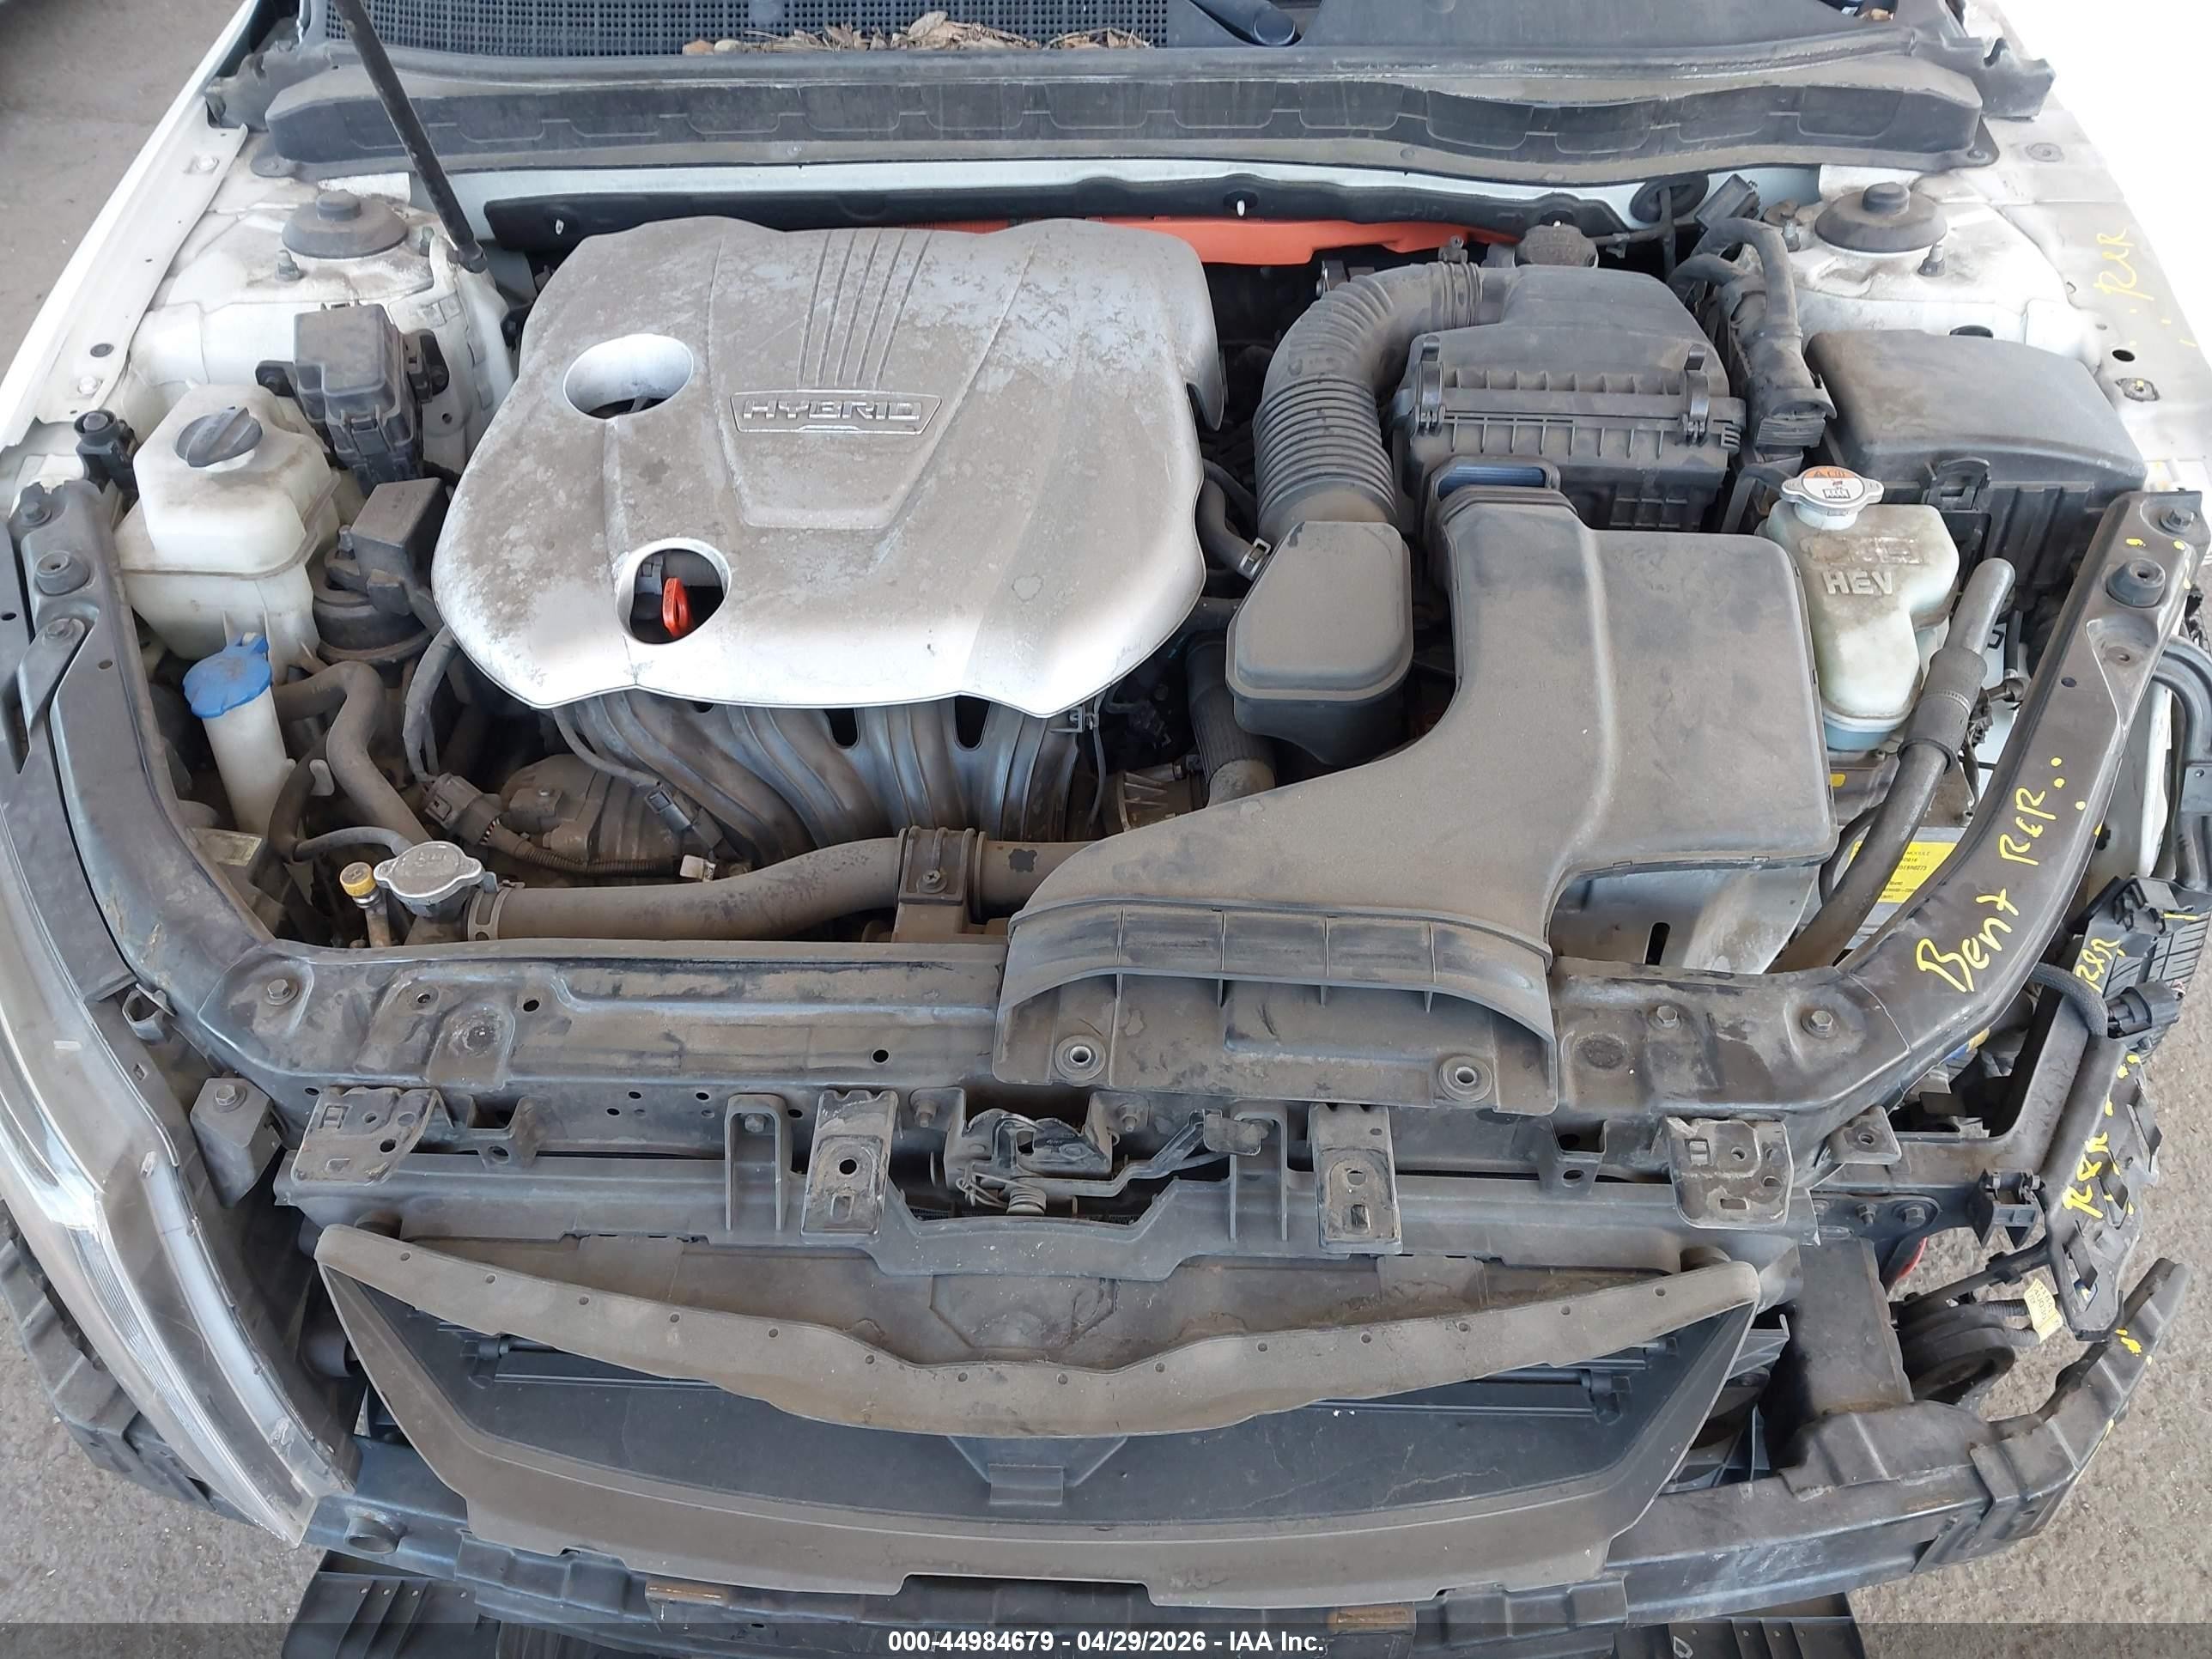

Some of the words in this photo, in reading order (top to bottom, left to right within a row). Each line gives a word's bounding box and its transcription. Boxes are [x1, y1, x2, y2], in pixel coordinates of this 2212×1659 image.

[743, 399, 922, 421] HYBRID
[1822, 569, 1893, 595] HEV
[1916, 887, 2020, 993] Bent
